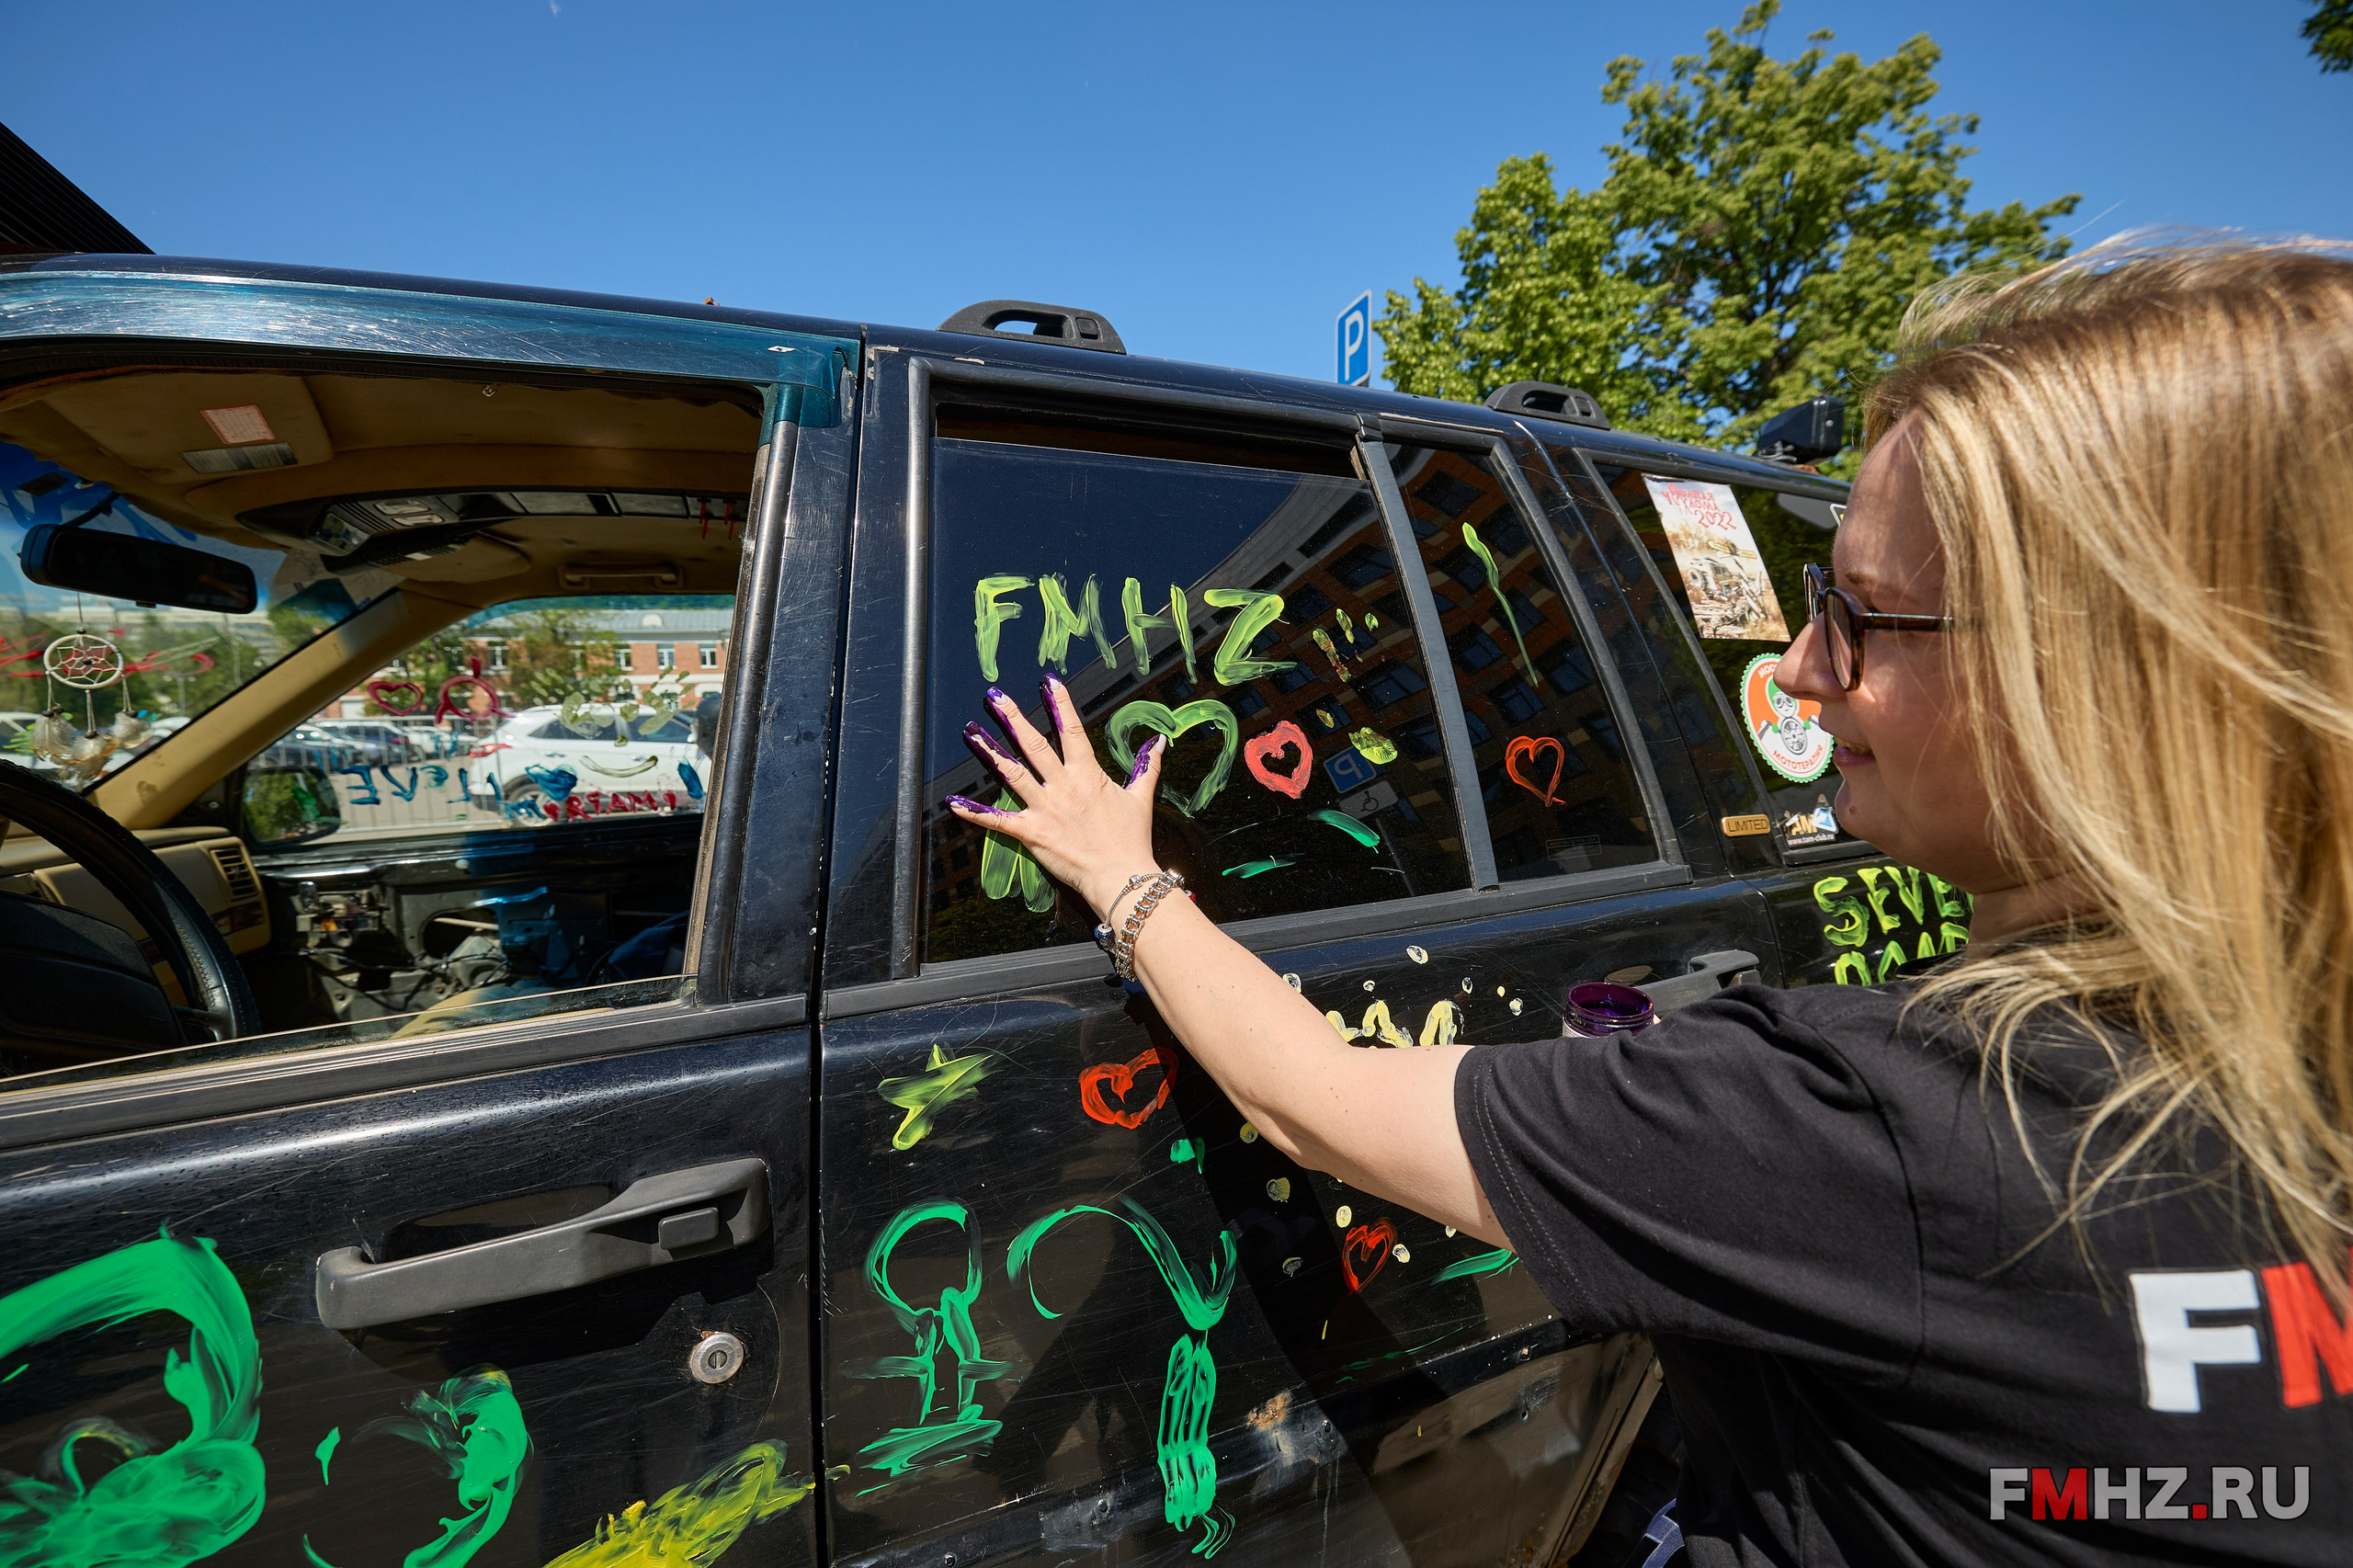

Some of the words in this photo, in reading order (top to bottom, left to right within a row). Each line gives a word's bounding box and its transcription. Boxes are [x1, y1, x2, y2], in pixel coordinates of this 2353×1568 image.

[1345, 310, 1365, 381] P
[1694, 510, 1737, 530] 2022
[974, 572, 1298, 686] FMHZ
[1773, 744, 1824, 770] МОТОТЕРАПИЯ
[1727, 818, 1768, 833] LIMITED
